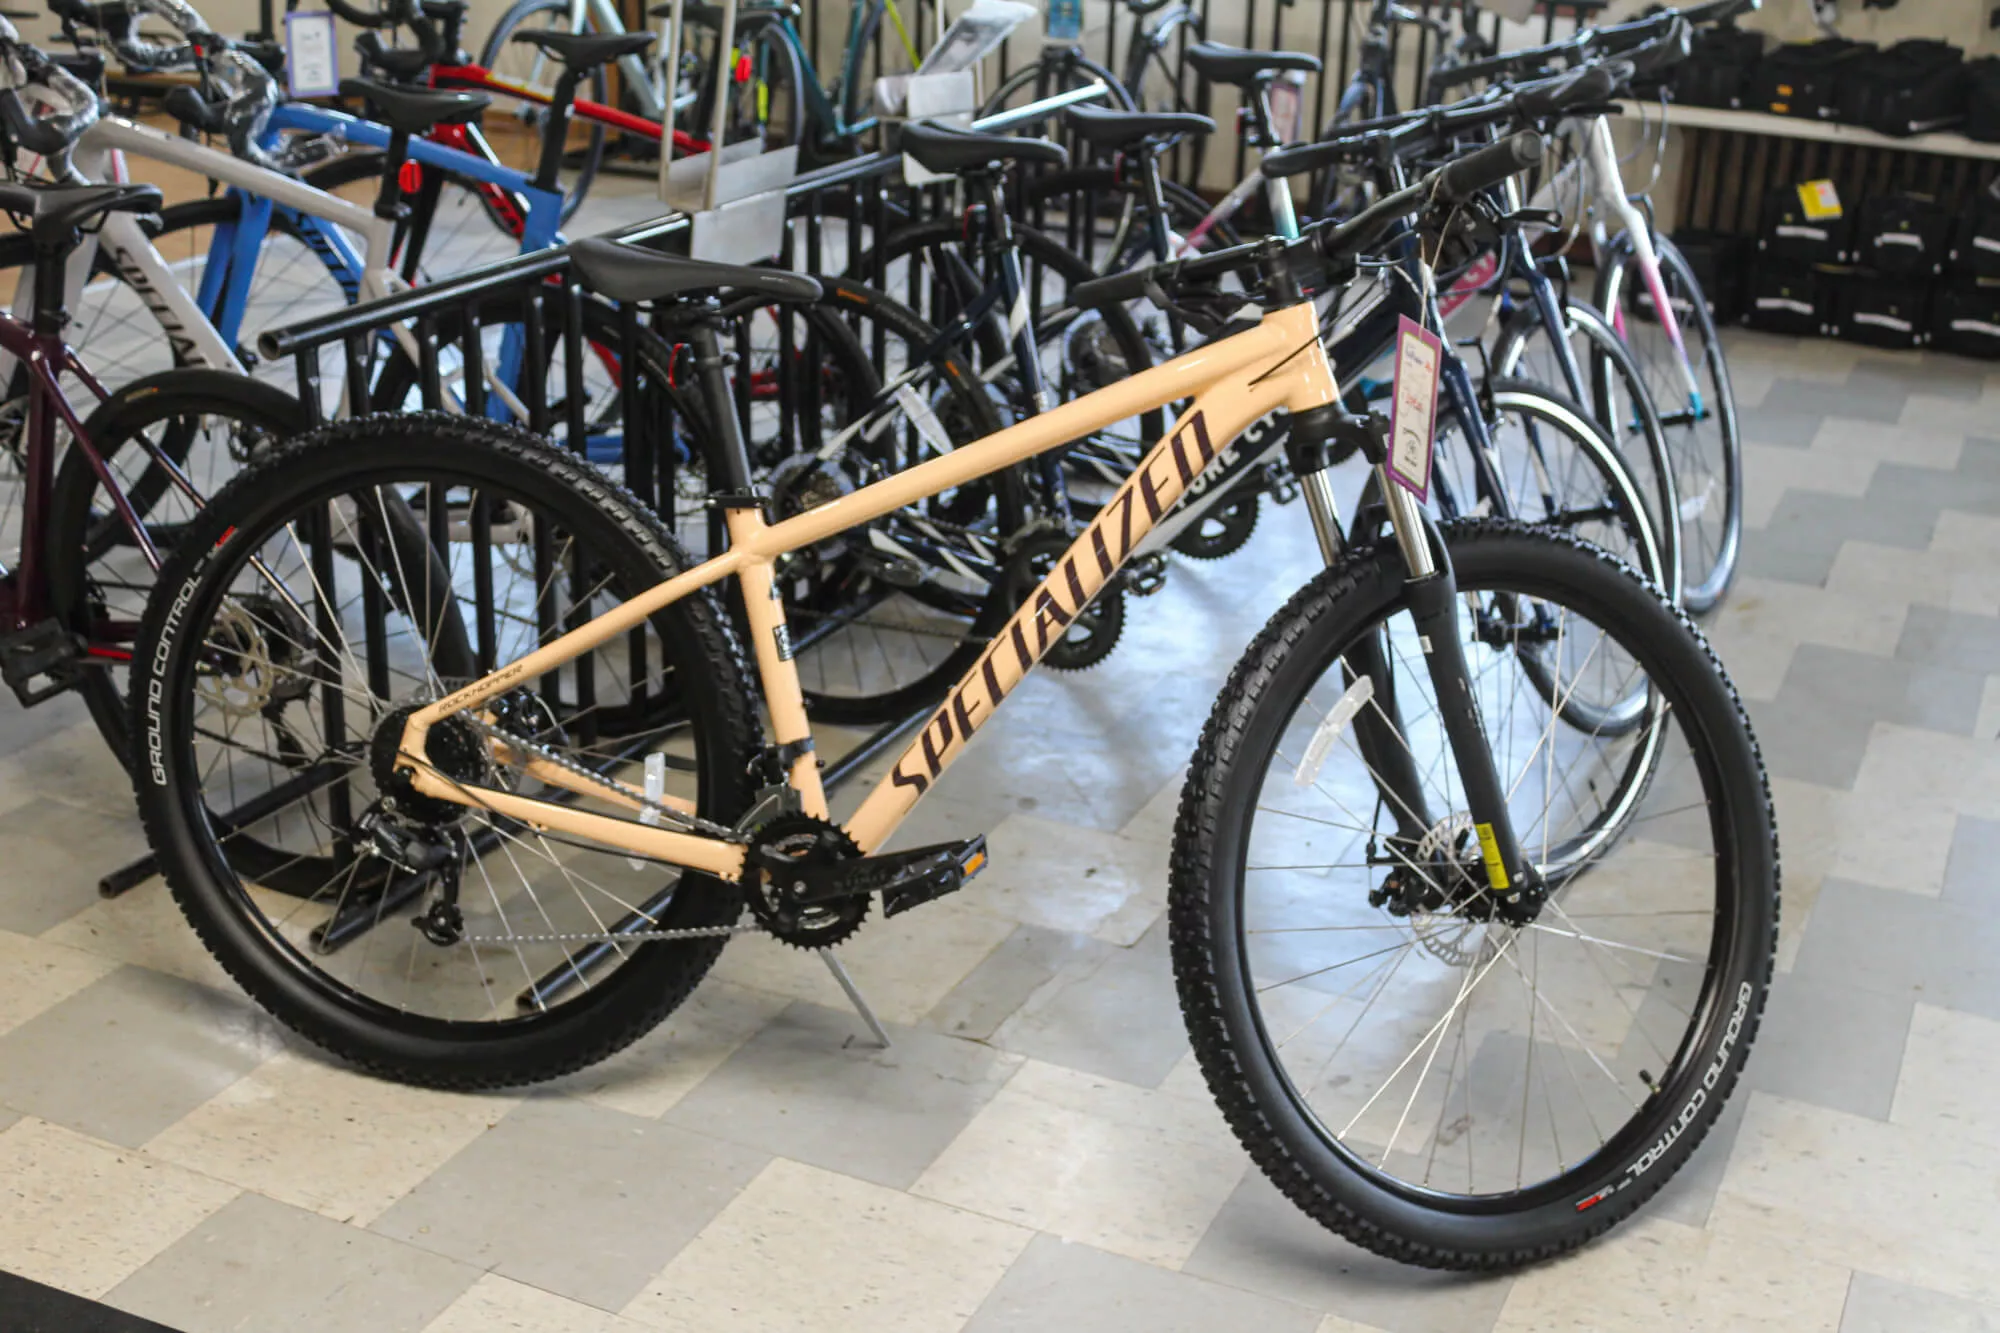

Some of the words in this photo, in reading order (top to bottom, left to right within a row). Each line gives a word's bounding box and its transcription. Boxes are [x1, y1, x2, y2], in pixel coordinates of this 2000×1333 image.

[153, 572, 204, 678] CONTROL
[892, 408, 1216, 796] SPECIALIZED
[146, 678, 168, 786] GROUND
[438, 664, 523, 713] ROCKHOPPER
[1703, 981, 1753, 1090] GROUND
[1626, 1089, 1708, 1178] CONTROL
